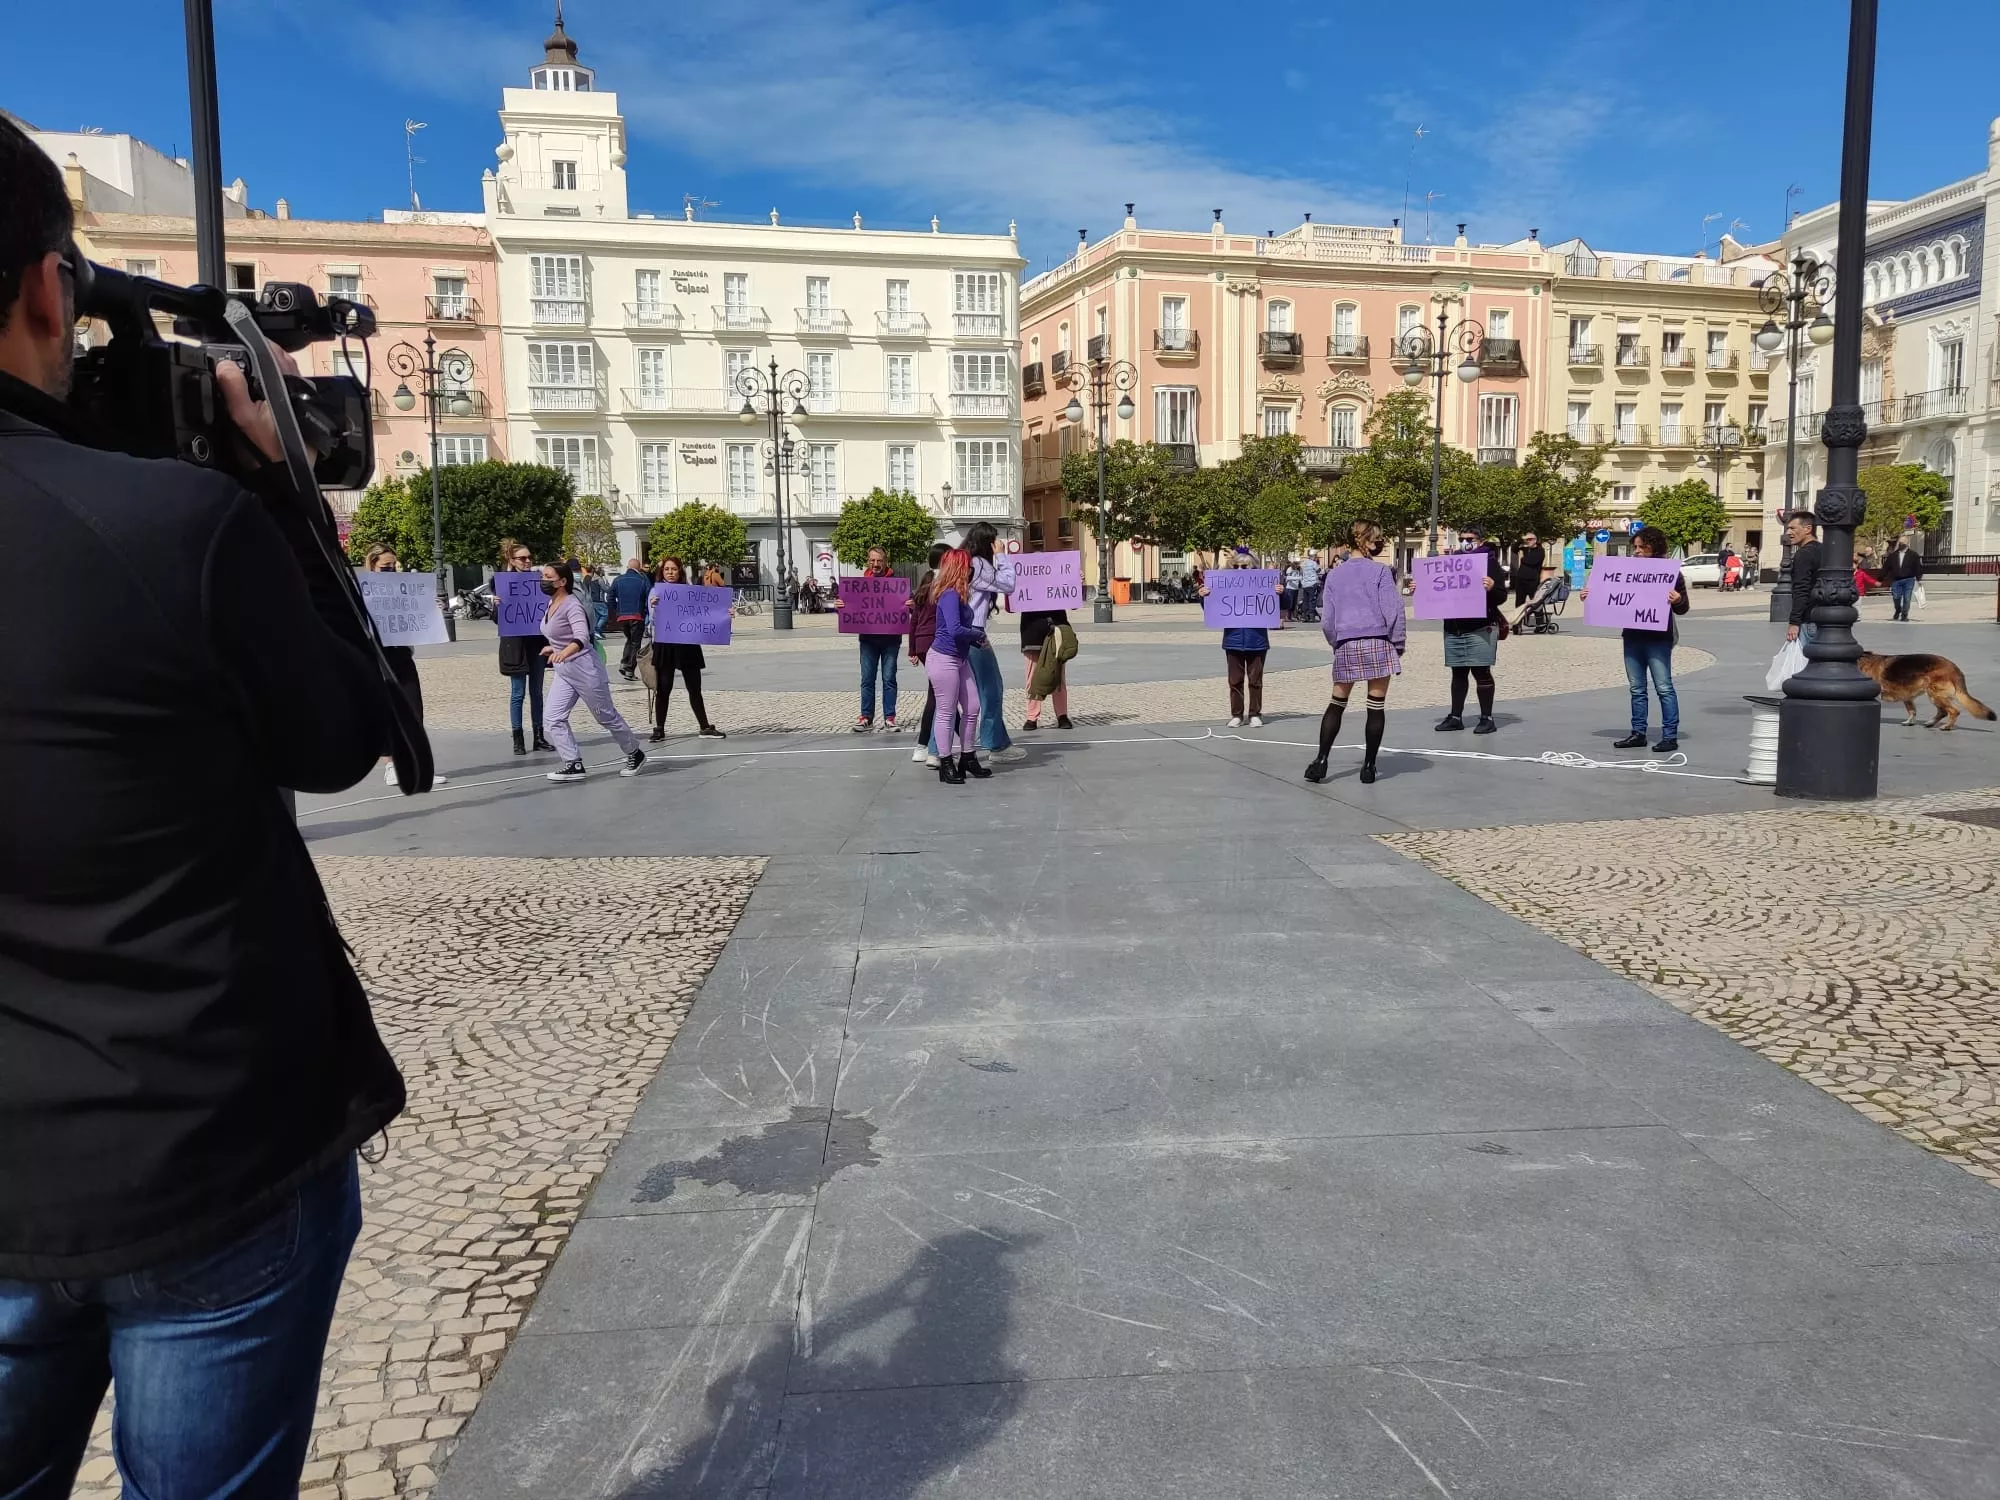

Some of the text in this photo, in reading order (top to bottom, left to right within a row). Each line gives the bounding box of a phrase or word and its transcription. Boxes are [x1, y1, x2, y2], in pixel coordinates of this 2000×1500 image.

[675, 281, 709, 295] Cajasol
[683, 454, 717, 466] Cajasol
[1015, 562, 1071, 576] QUIERO IR
[1424, 559, 1472, 574] TENGO
[1208, 576, 1278, 588] TENGO MUCHO
[1433, 575, 1471, 591] SED
[1604, 572, 1675, 583] ME ENCUENTRO
[400, 583, 425, 596] QUE
[509, 580, 541, 596] EST
[843, 581, 906, 593] TRABAJO
[1018, 584, 1077, 601] AL BAÑO
[664, 589, 718, 603] NO PUEDO
[862, 597, 884, 608] SIN
[1608, 593, 1634, 605] MUY
[372, 597, 418, 610] TENGO
[1221, 593, 1275, 616] SUEÑO
[504, 602, 546, 624] CANS
[677, 605, 710, 616] PARAR
[1635, 609, 1659, 623] MAL
[374, 614, 428, 633] FIEBRE
[843, 612, 907, 625] DESCANSO
[665, 622, 715, 634] A COMER
